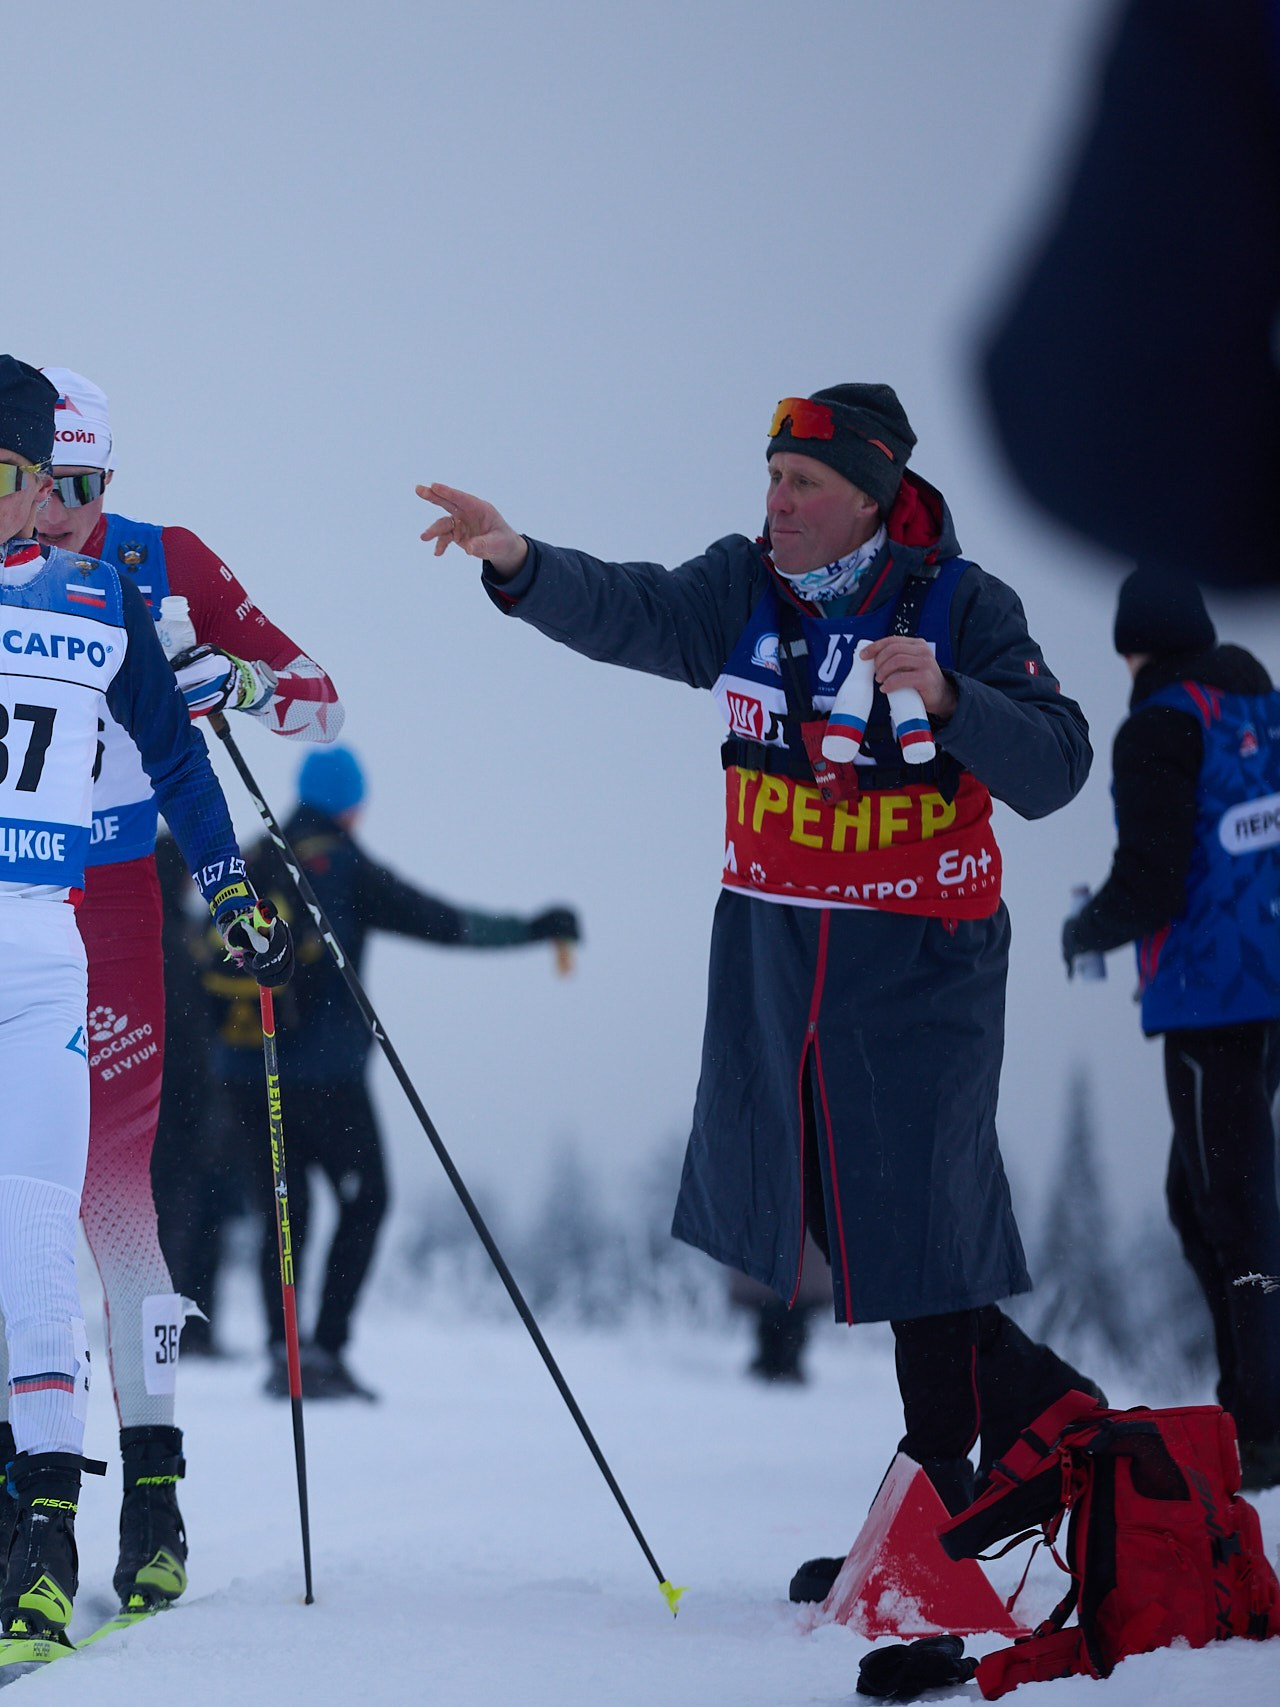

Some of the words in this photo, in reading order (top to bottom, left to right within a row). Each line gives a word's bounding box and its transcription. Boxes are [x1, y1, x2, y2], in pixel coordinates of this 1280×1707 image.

[735, 766, 957, 853] ТРЕНЕР
[940, 876, 997, 900] GROUP
[89, 1023, 153, 1067] ФОСАГРО
[100, 1041, 158, 1081] BIVIUM
[268, 1074, 283, 1123] LEKI
[154, 1324, 178, 1365] 36
